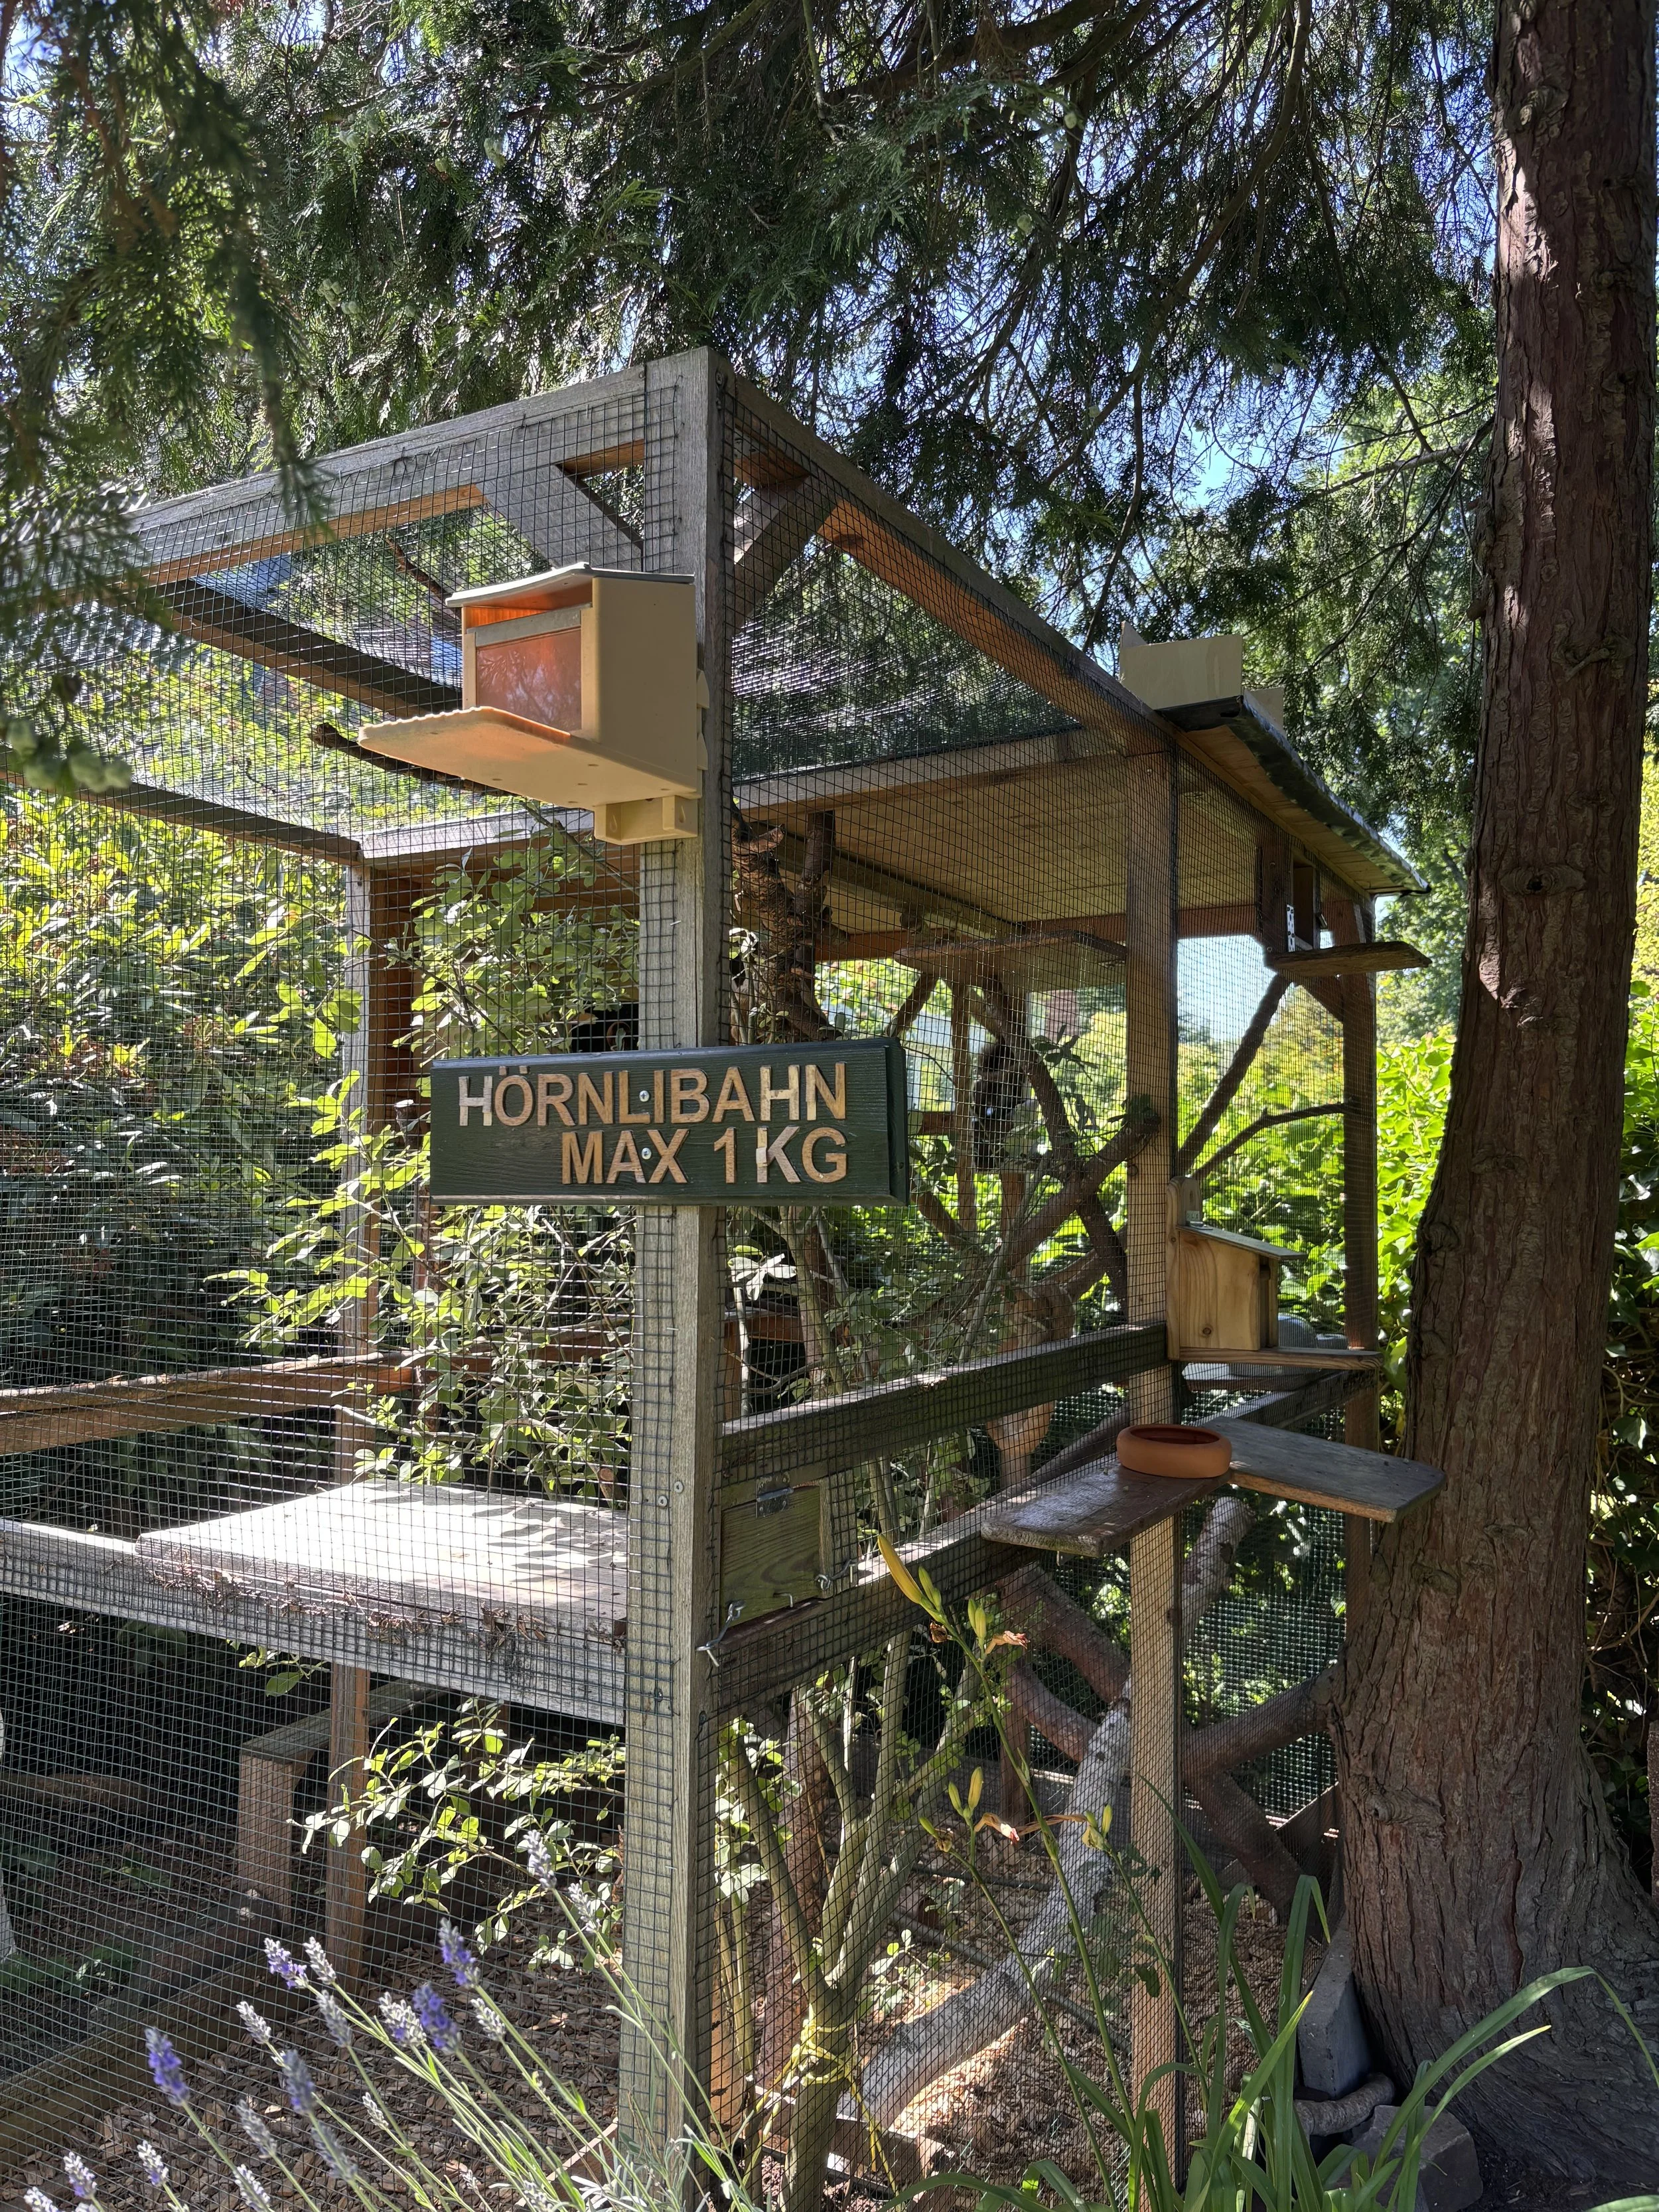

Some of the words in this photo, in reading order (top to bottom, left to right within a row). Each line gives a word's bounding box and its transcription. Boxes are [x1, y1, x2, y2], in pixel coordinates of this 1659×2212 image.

[458, 1062, 847, 1127] HÖRNLIBAHN
[561, 1128, 690, 1185] MAX
[713, 1128, 737, 1184] 1
[755, 1126, 848, 1184] KG
